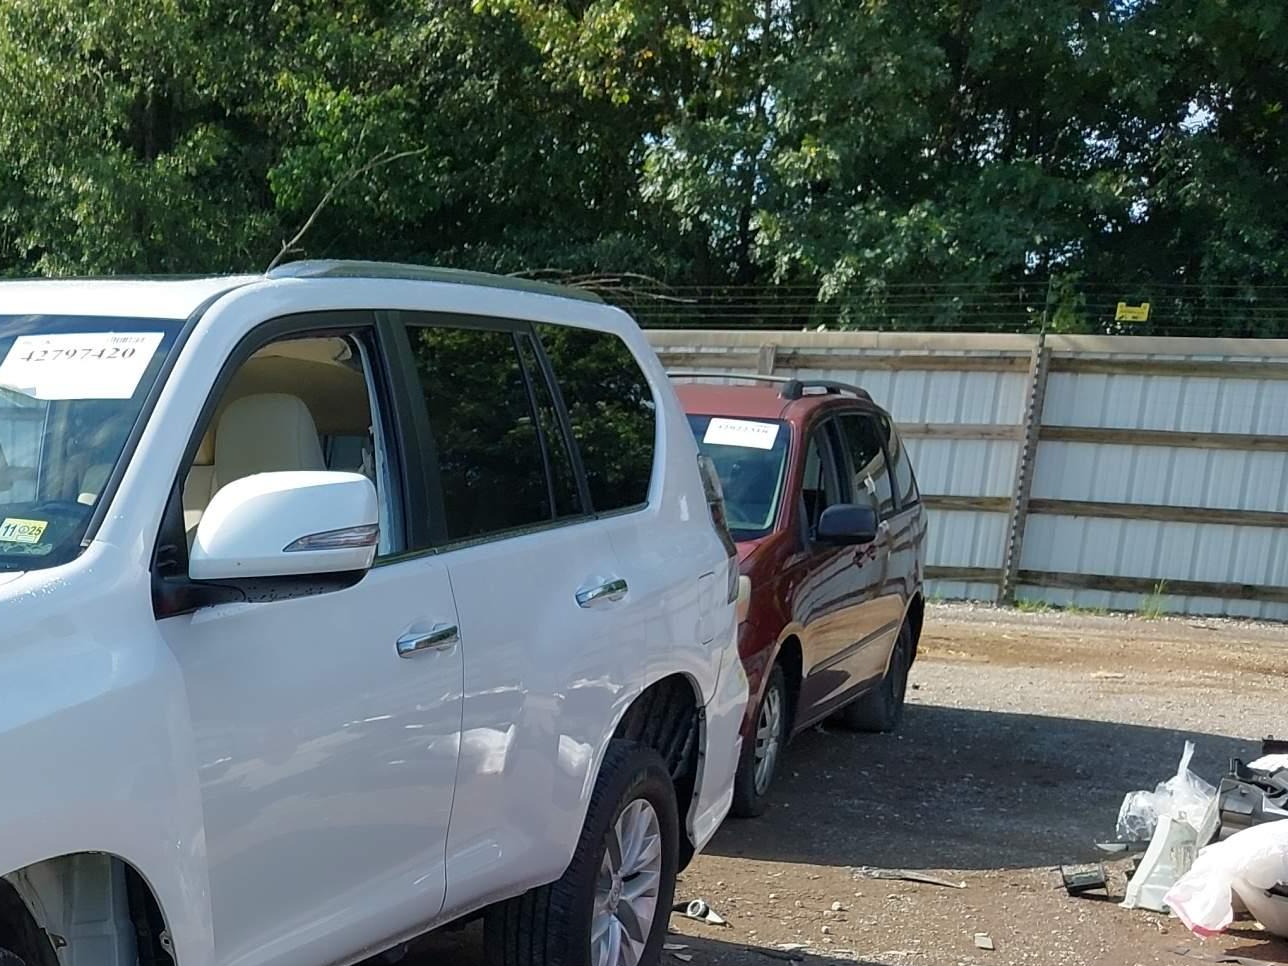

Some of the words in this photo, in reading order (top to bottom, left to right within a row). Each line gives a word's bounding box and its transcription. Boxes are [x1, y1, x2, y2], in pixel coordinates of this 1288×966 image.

[20, 347, 137, 363] 42797420
[2, 523, 18, 537] 11
[28, 525, 44, 537] 25
